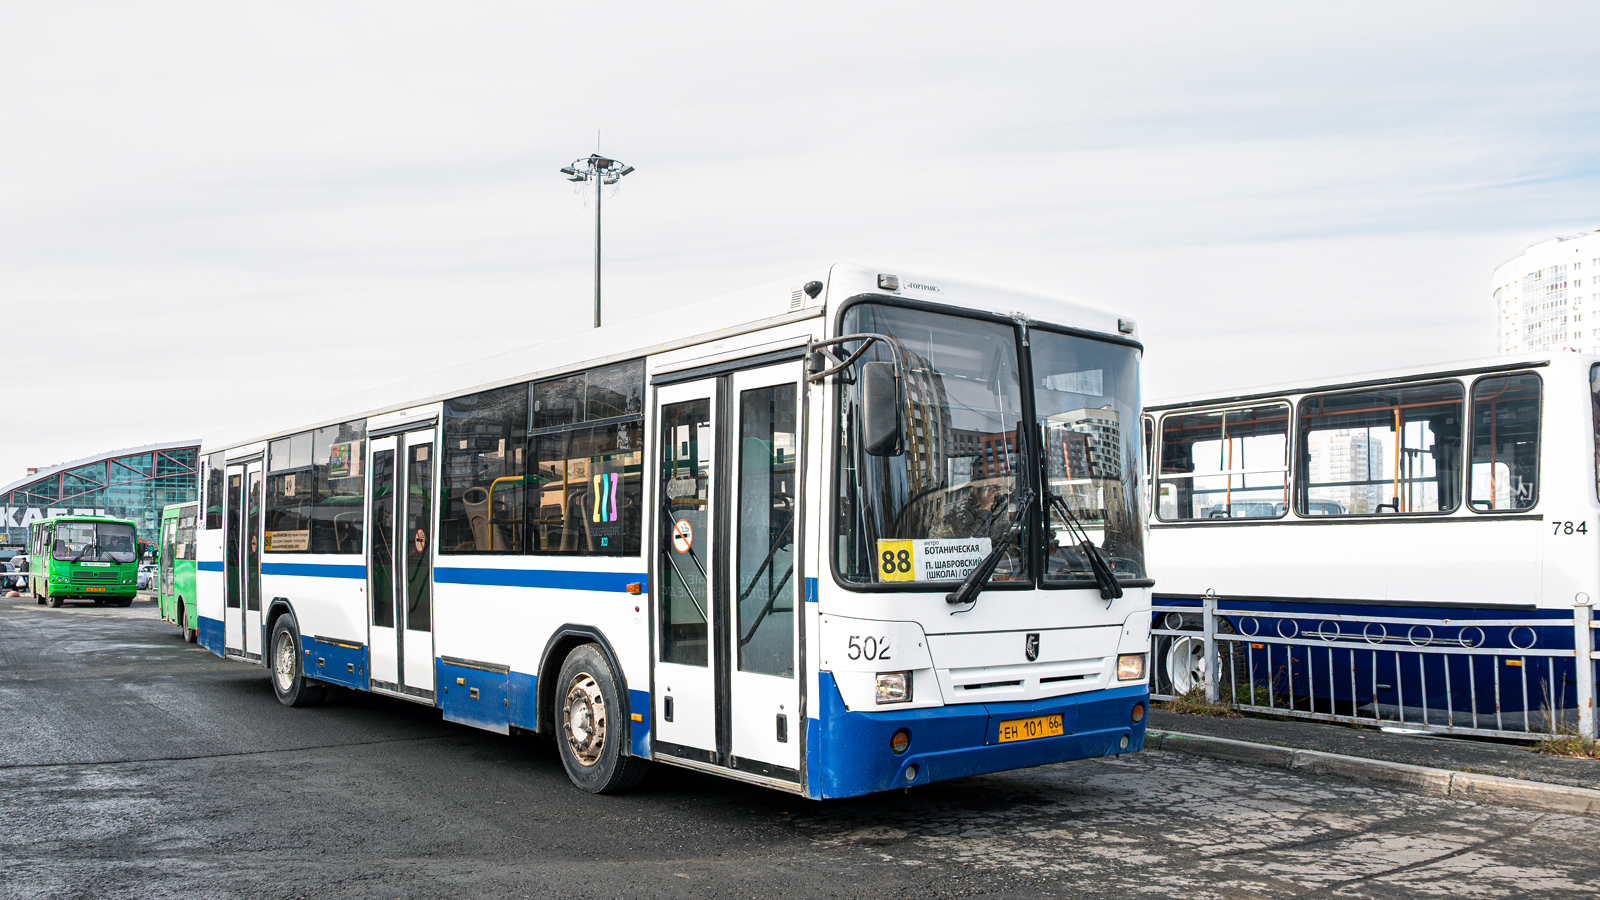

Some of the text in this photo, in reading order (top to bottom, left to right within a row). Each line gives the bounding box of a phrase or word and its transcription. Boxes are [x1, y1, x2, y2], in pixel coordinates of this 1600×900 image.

[1551, 521, 1588, 535] 784
[924, 544, 980, 555] БОТАНИЧЕСКАЯ
[882, 550, 911, 574] 88
[934, 557, 983, 569] ШАБРОВСКИЙ
[926, 568, 958, 580] (ШКОЛА)
[847, 635, 891, 660] 502
[1023, 719, 1043, 737] 101
[1048, 717, 1059, 729] 66
